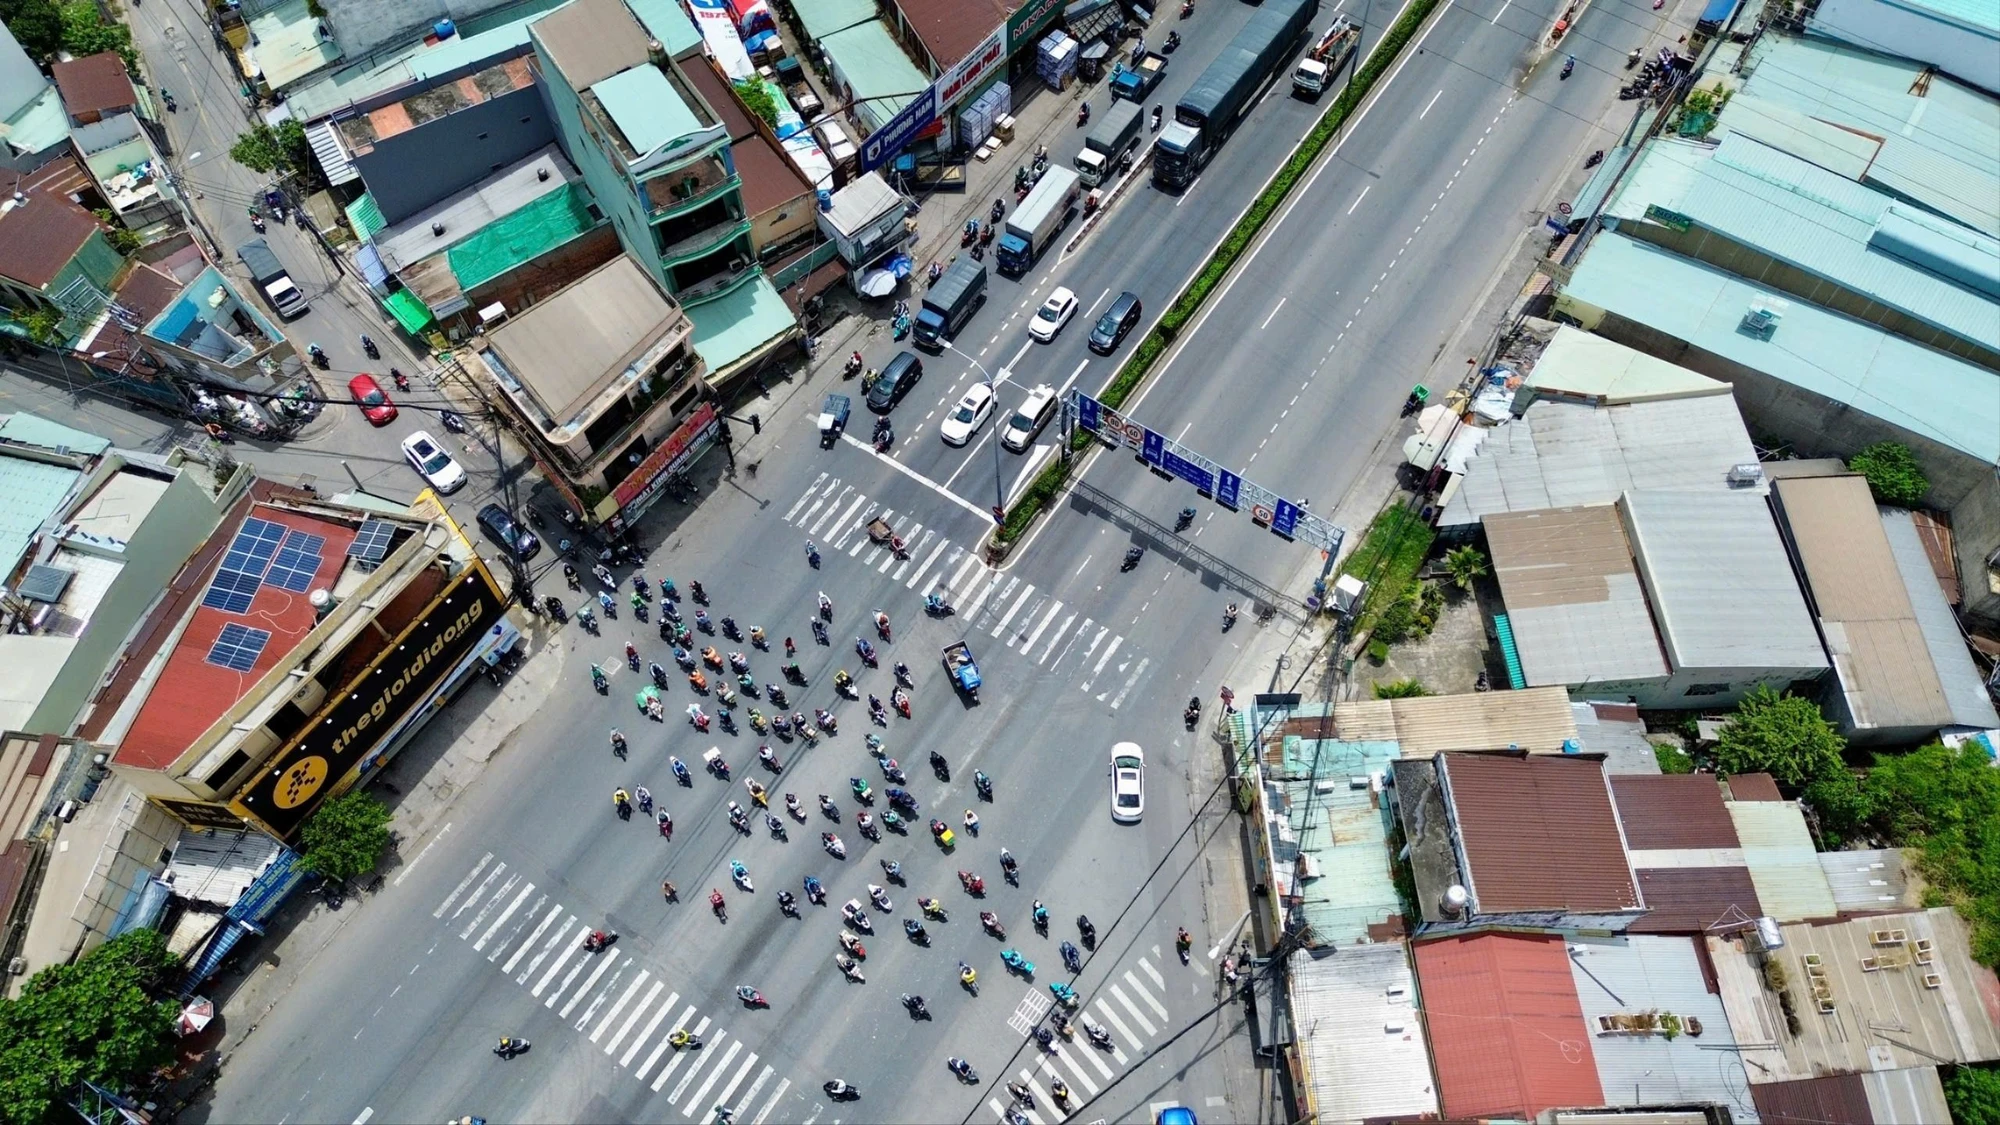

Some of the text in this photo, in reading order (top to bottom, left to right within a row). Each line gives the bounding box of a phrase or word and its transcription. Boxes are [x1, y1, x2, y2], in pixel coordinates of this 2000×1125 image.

[1129, 428, 1139, 438] 60
[1258, 510, 1268, 520] 50
[330, 597, 484, 755] thegioididong
